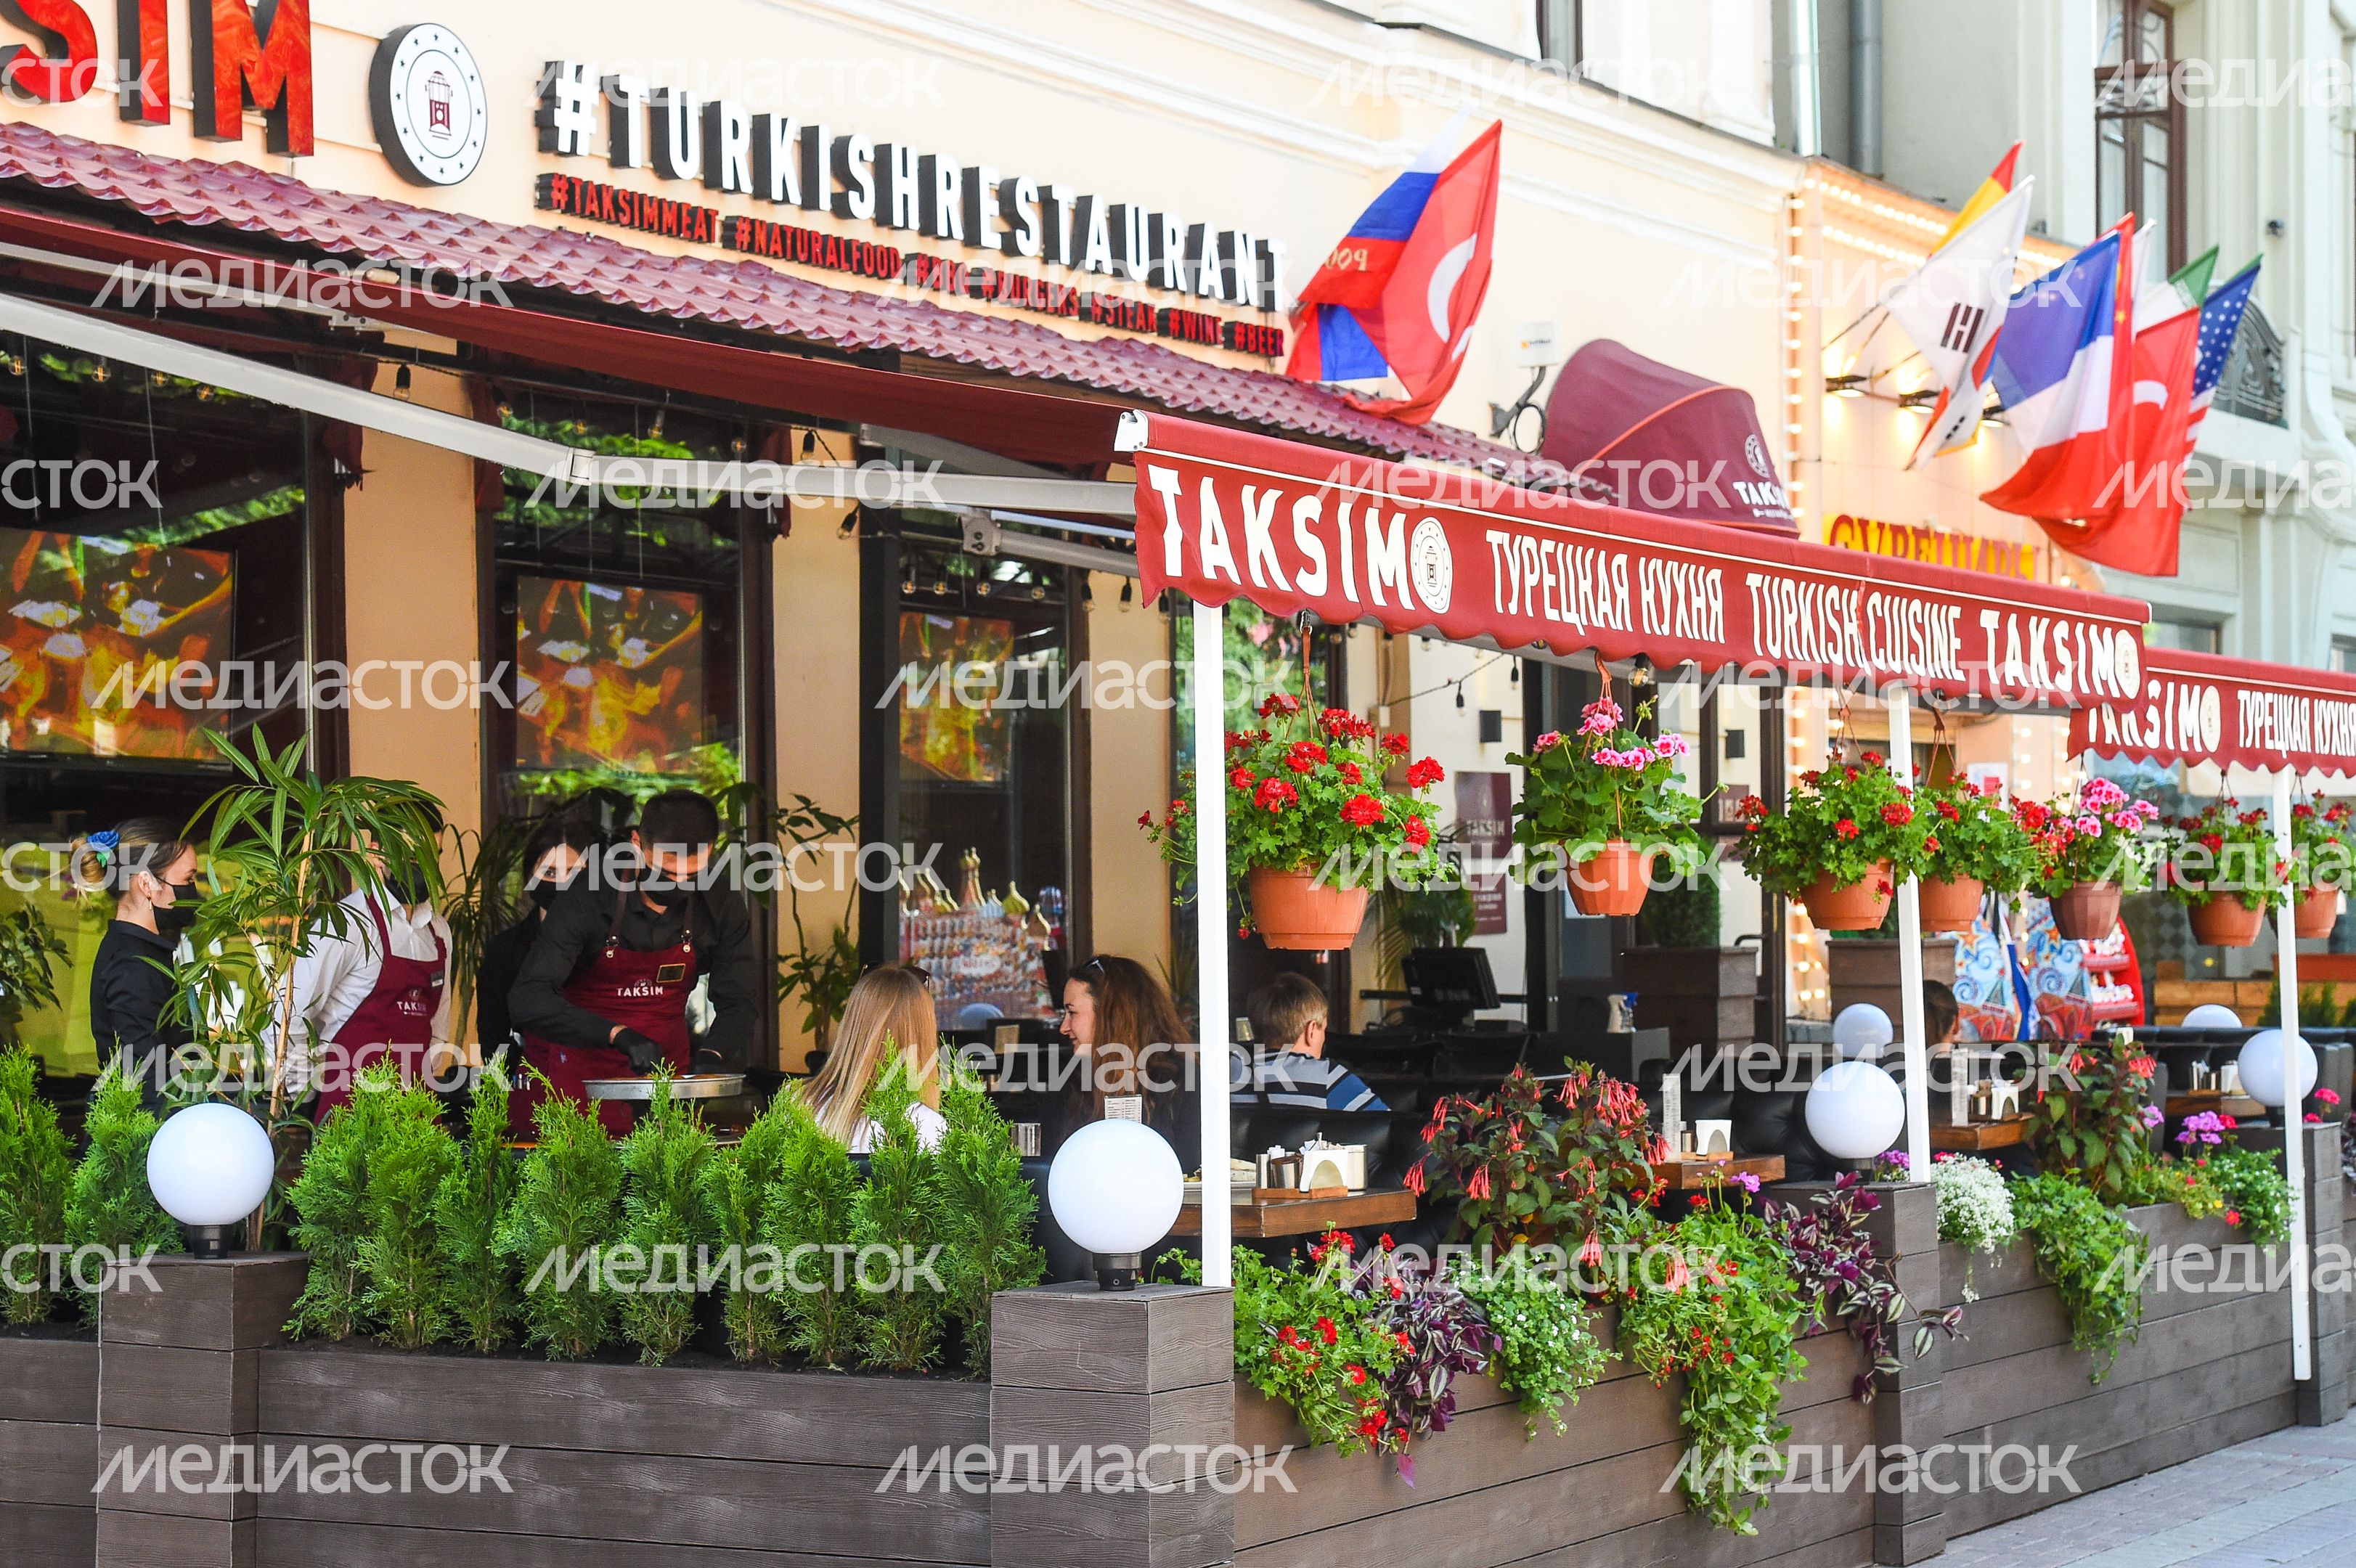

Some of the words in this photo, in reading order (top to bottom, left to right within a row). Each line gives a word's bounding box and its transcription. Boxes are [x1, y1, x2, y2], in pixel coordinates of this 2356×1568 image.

[553, 60, 1287, 312] #TURKISHRESTAURANT
[550, 173, 719, 243] #TAKSIMMEAT
[735, 216, 901, 279] #NATURALFOOD
[981, 266, 1079, 317] #BURGERS
[1091, 292, 1157, 333] #STEAK
[1169, 308, 1223, 346] #WINE
[1235, 321, 1284, 357] #BEER
[1148, 463, 1416, 611] TAKSIM
[1732, 481, 1791, 510] TAK
[1485, 529, 1634, 637] ТУРЕЦКАЯ
[1638, 556, 1726, 645] КУХНЯ
[1745, 573, 1869, 674] TURKISH
[1867, 592, 1966, 682] CUISINE
[1980, 608, 2121, 698] TAKSIM
[2237, 689, 2312, 759] ТУРЕЦКАЯ
[2314, 698, 2356, 757] КУХНЯ
[616, 987, 664, 997] TAKSIM
